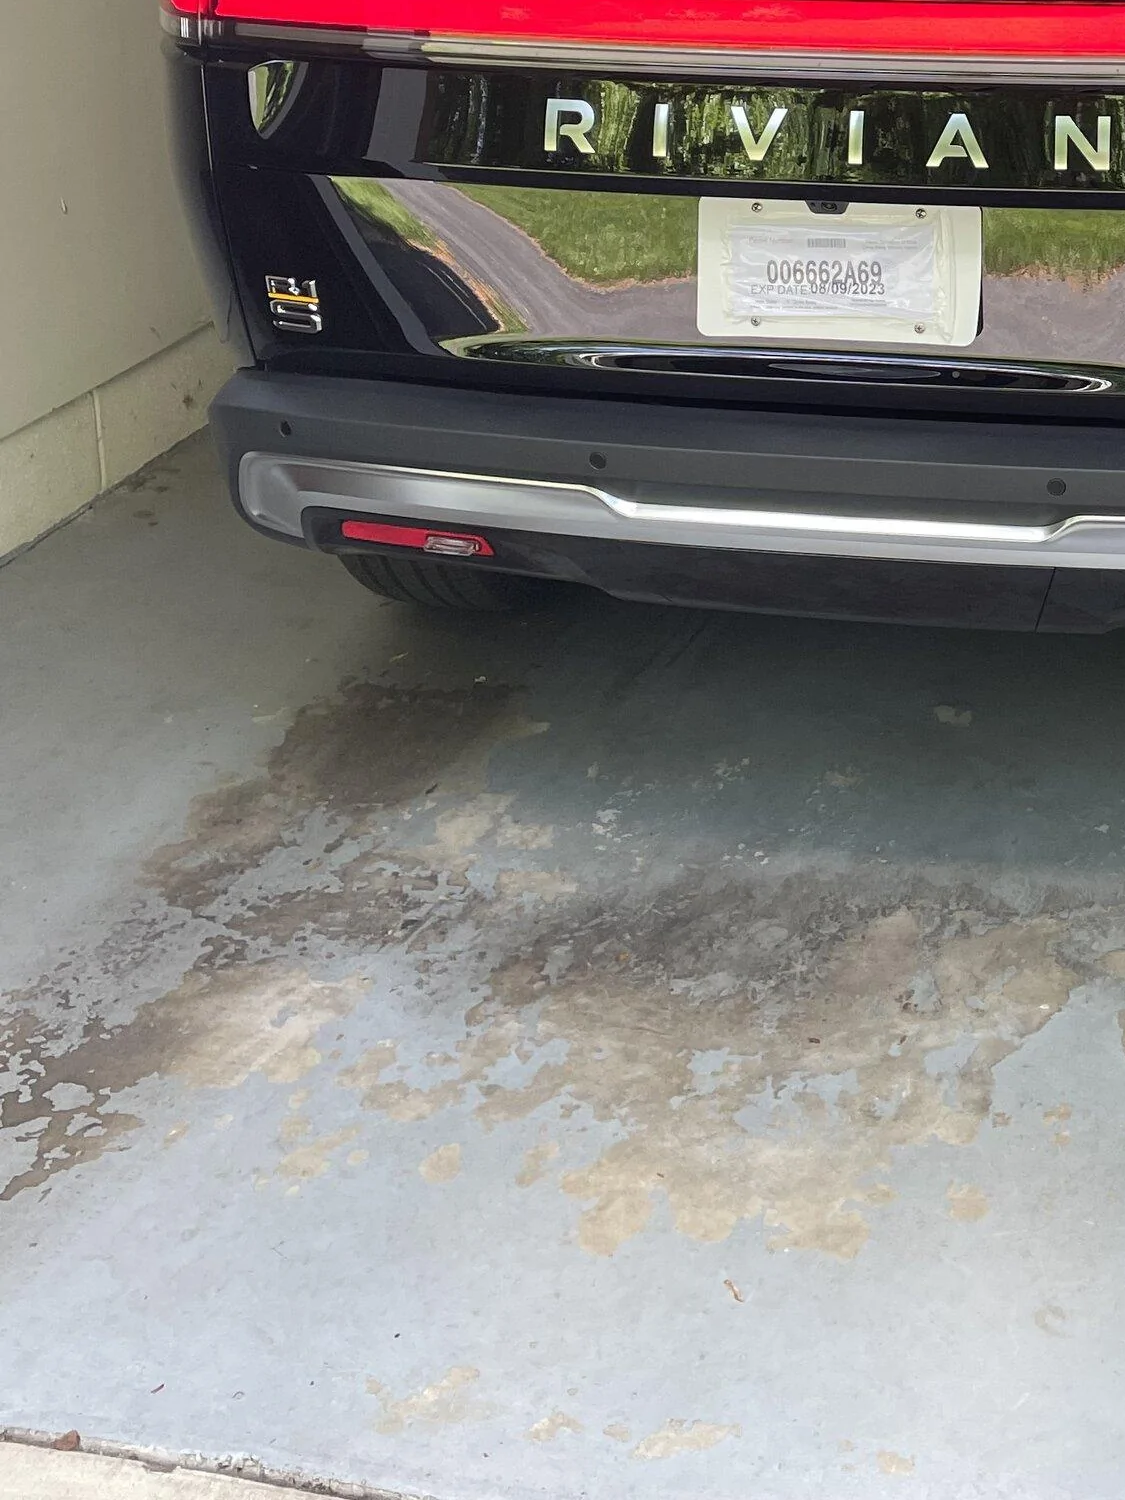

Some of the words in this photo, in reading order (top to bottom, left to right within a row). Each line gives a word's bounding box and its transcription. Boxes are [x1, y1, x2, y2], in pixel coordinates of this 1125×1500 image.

[543, 98, 1112, 171] RIVIAN
[767, 260, 882, 285] 006662A69
[751, 285, 774, 295] EXP
